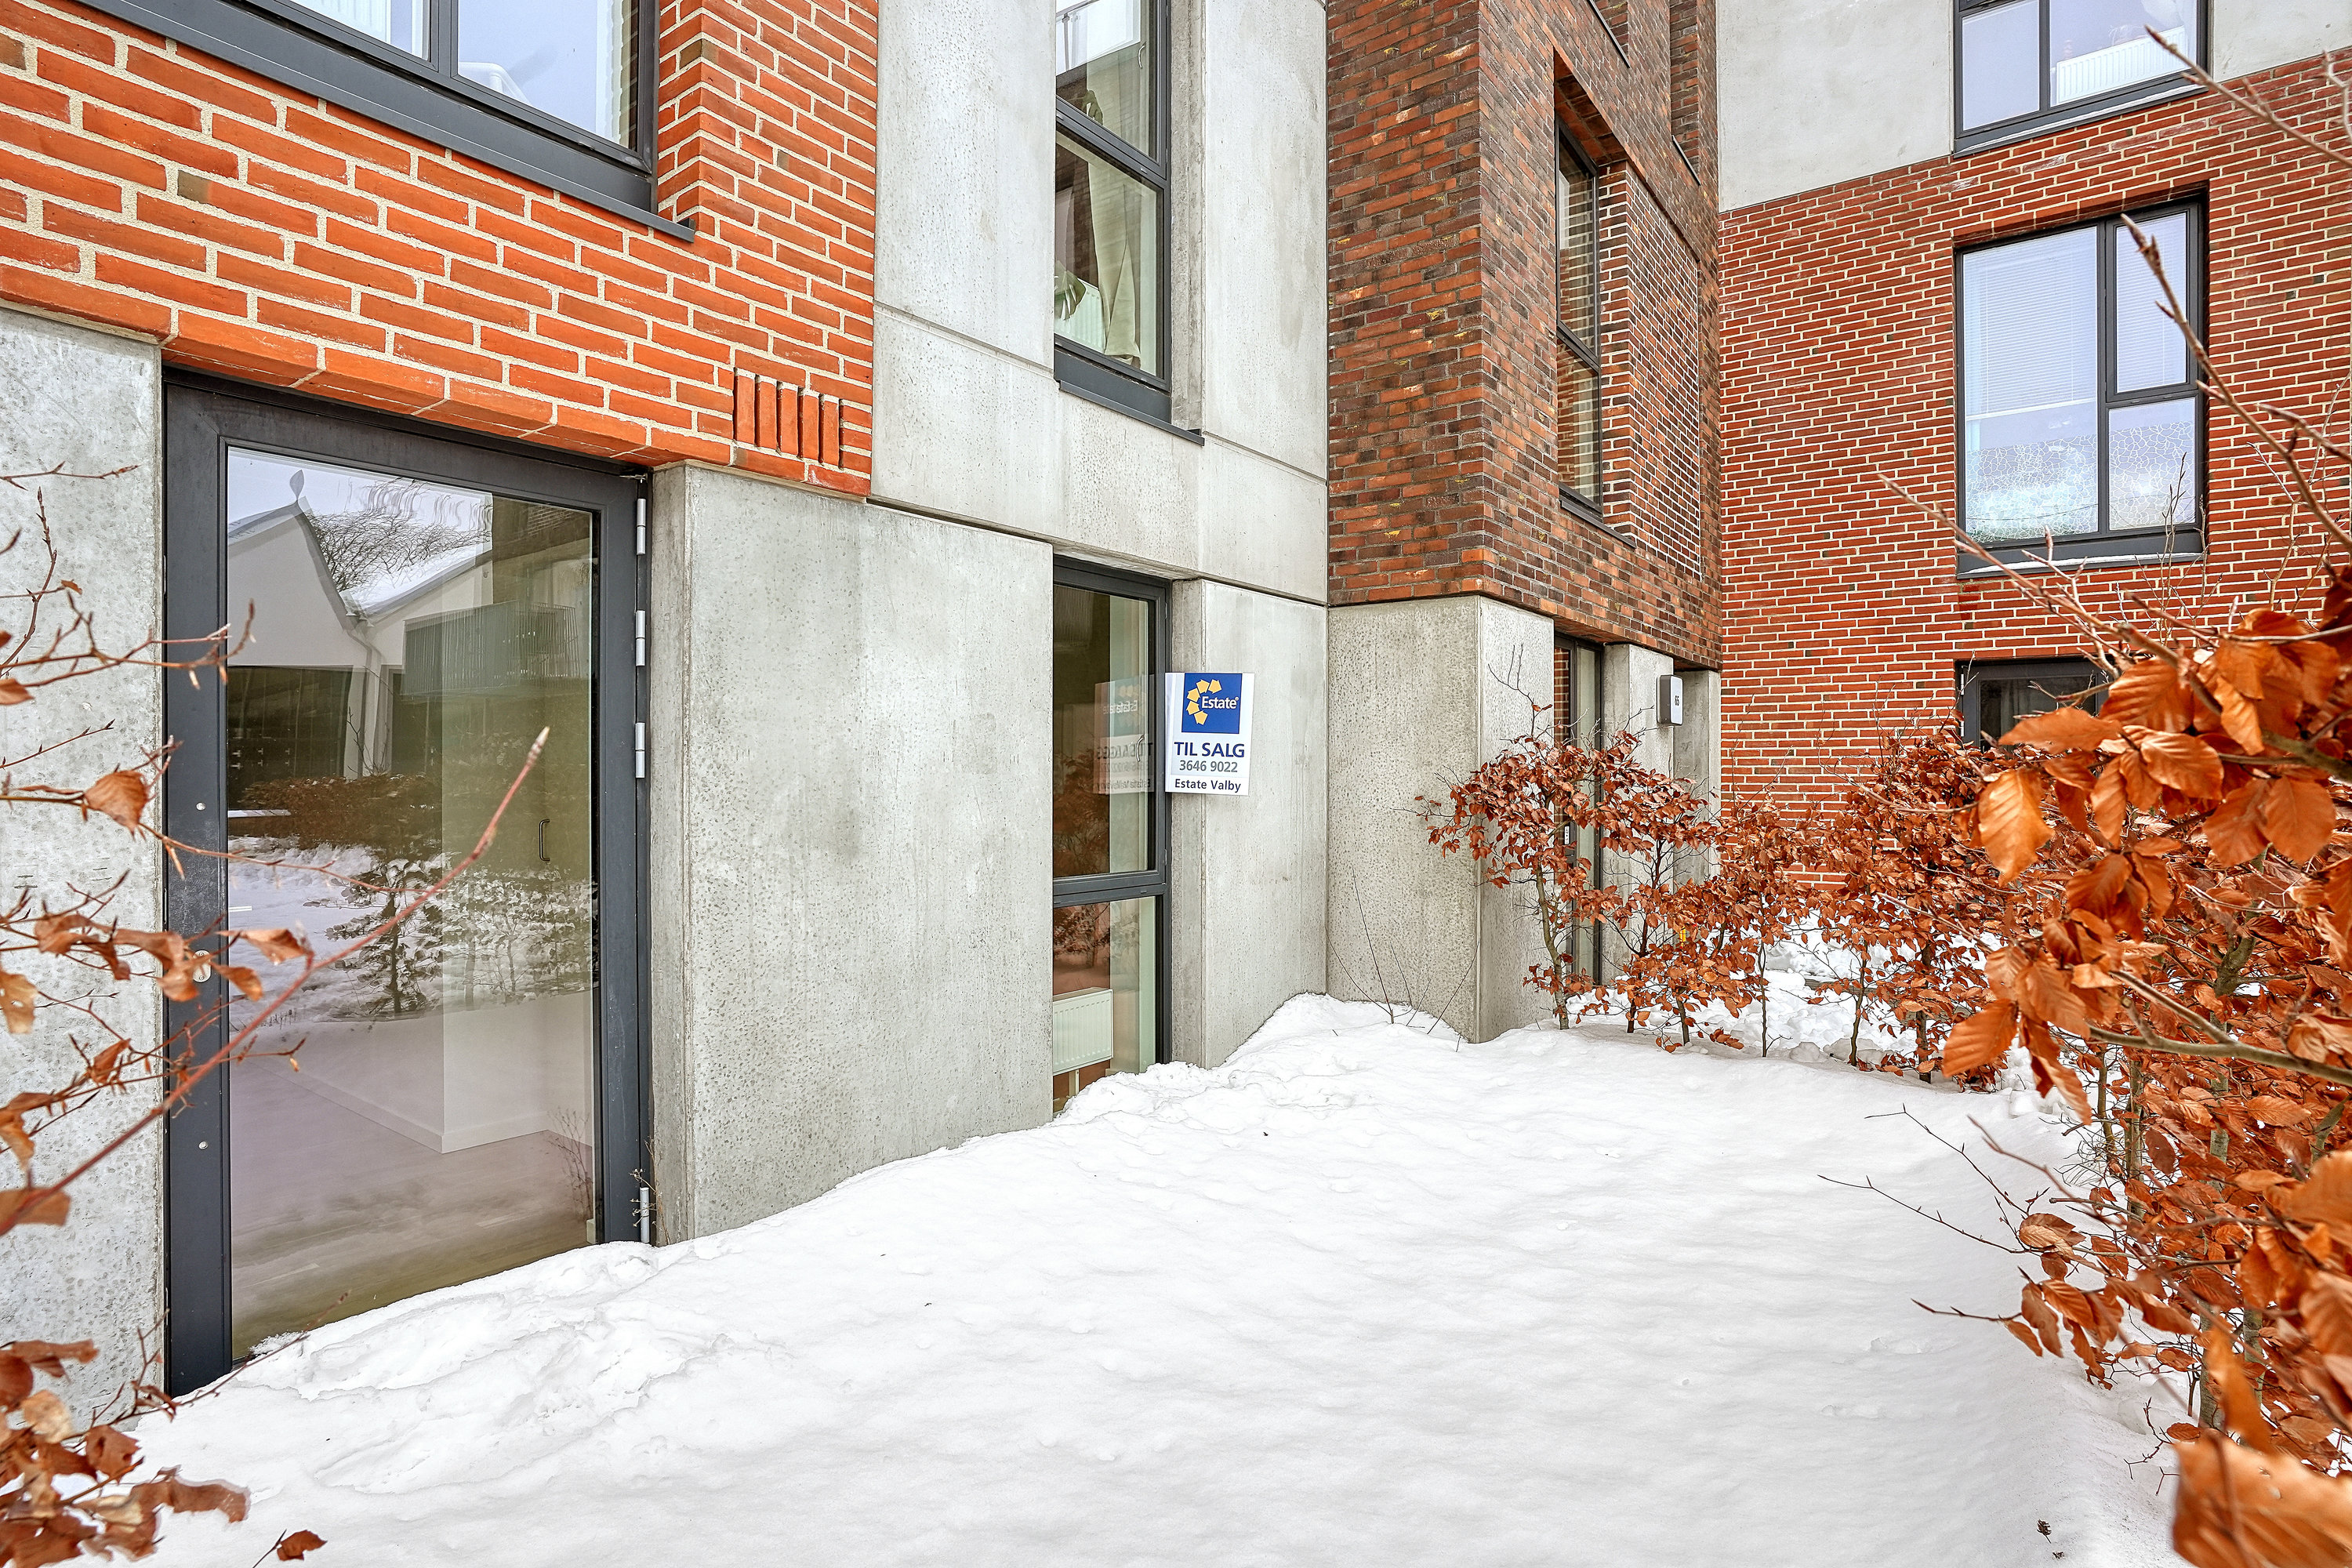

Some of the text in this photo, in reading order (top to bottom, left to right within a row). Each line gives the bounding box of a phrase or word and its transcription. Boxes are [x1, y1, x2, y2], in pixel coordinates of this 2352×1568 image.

[1174, 742, 1245, 758] TIL SALG
[1179, 760, 1238, 773] 3646 9022
[1174, 779, 1241, 793] Estate Valby
